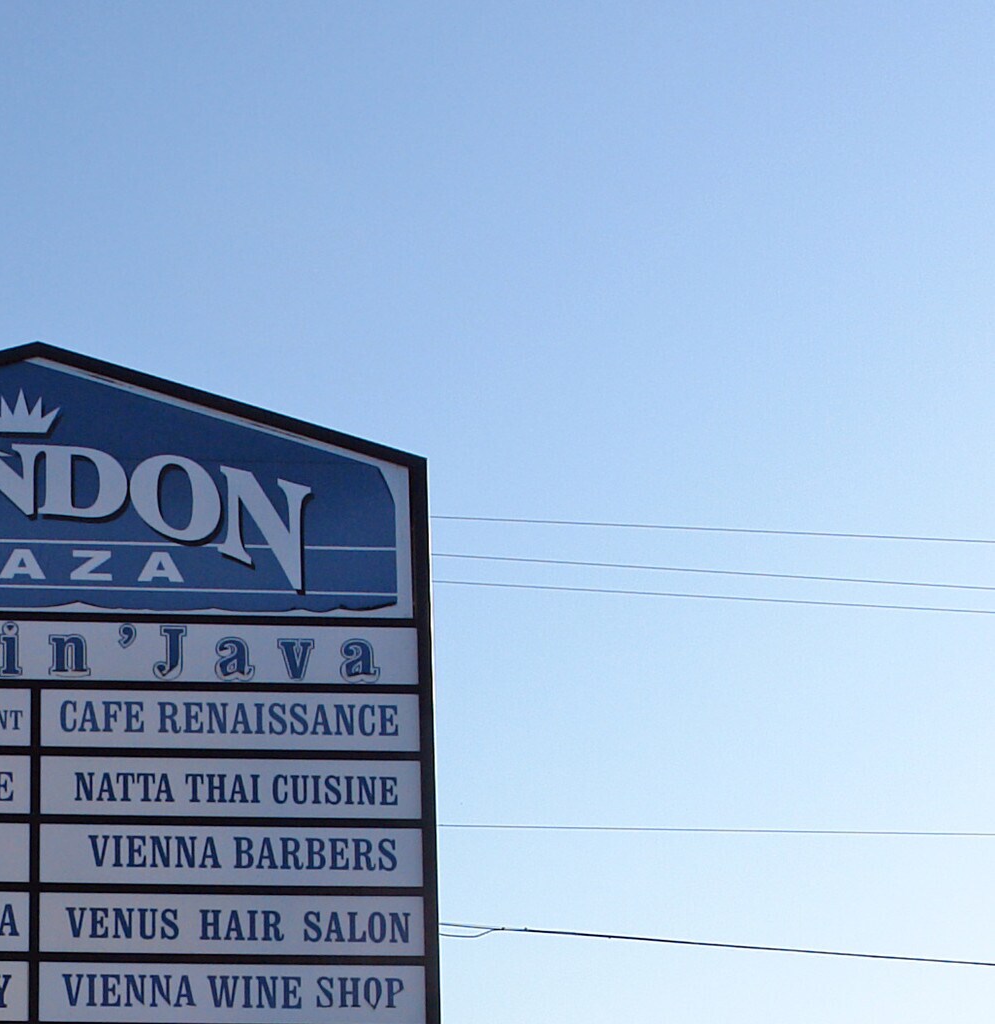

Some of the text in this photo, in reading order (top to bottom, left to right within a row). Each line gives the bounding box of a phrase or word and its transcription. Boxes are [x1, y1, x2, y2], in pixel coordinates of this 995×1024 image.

[59, 699, 400, 737] CAFE RENAISSANCE
[74, 771, 399, 806] NATTA THAI CUISINE
[87, 834, 398, 872] VIENNA BARBERS
[65, 906, 411, 944] VENUS HAIR SALON
[61, 973, 405, 1010] VIENNA WINE SHOP
